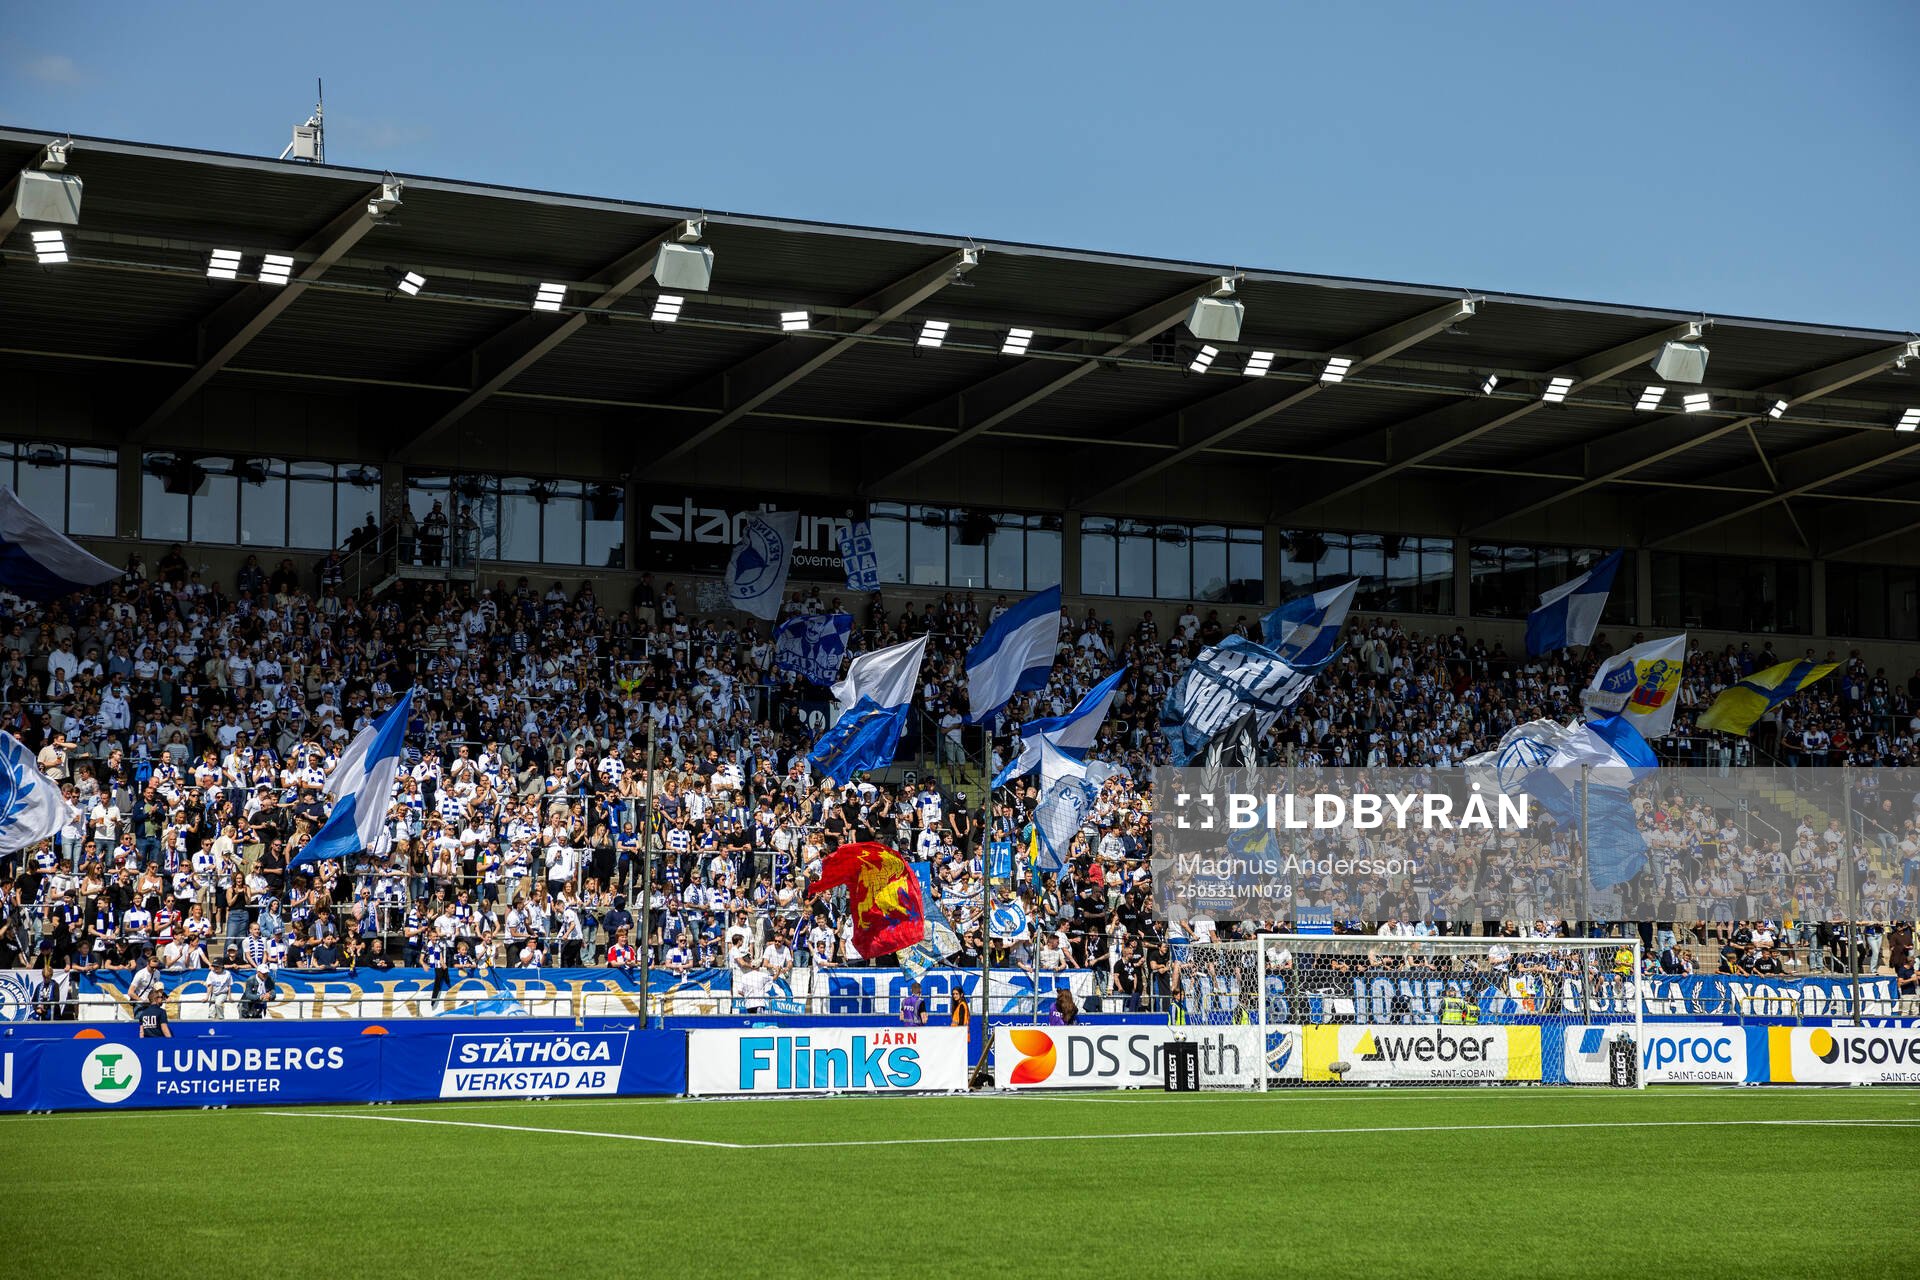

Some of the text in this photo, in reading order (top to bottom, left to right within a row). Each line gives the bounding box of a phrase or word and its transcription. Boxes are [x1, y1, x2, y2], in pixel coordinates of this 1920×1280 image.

[459, 1034, 610, 1064] STÅTHÖGA
[873, 1030, 918, 1045] JÄRN
[1385, 1029, 1495, 1062] weber
[157, 1046, 344, 1073] LUNDBERGS
[739, 1034, 922, 1089] Flinks
[1068, 1033, 1240, 1077] DS Sth
[1617, 1051, 1627, 1086] SELECT
[1643, 1037, 1732, 1070] yproc
[102, 1067, 115, 1077] LE
[157, 1078, 281, 1095] FASTIGHETER
[455, 1070, 606, 1092] VERKSTAD AB
[1168, 1053, 1178, 1090] SELECT
[1186, 1053, 1195, 1090] SELECT
[1430, 1068, 1495, 1078] SAINT-GOBAIN
[1668, 1071, 1733, 1080] SAINT-GOBAIN
